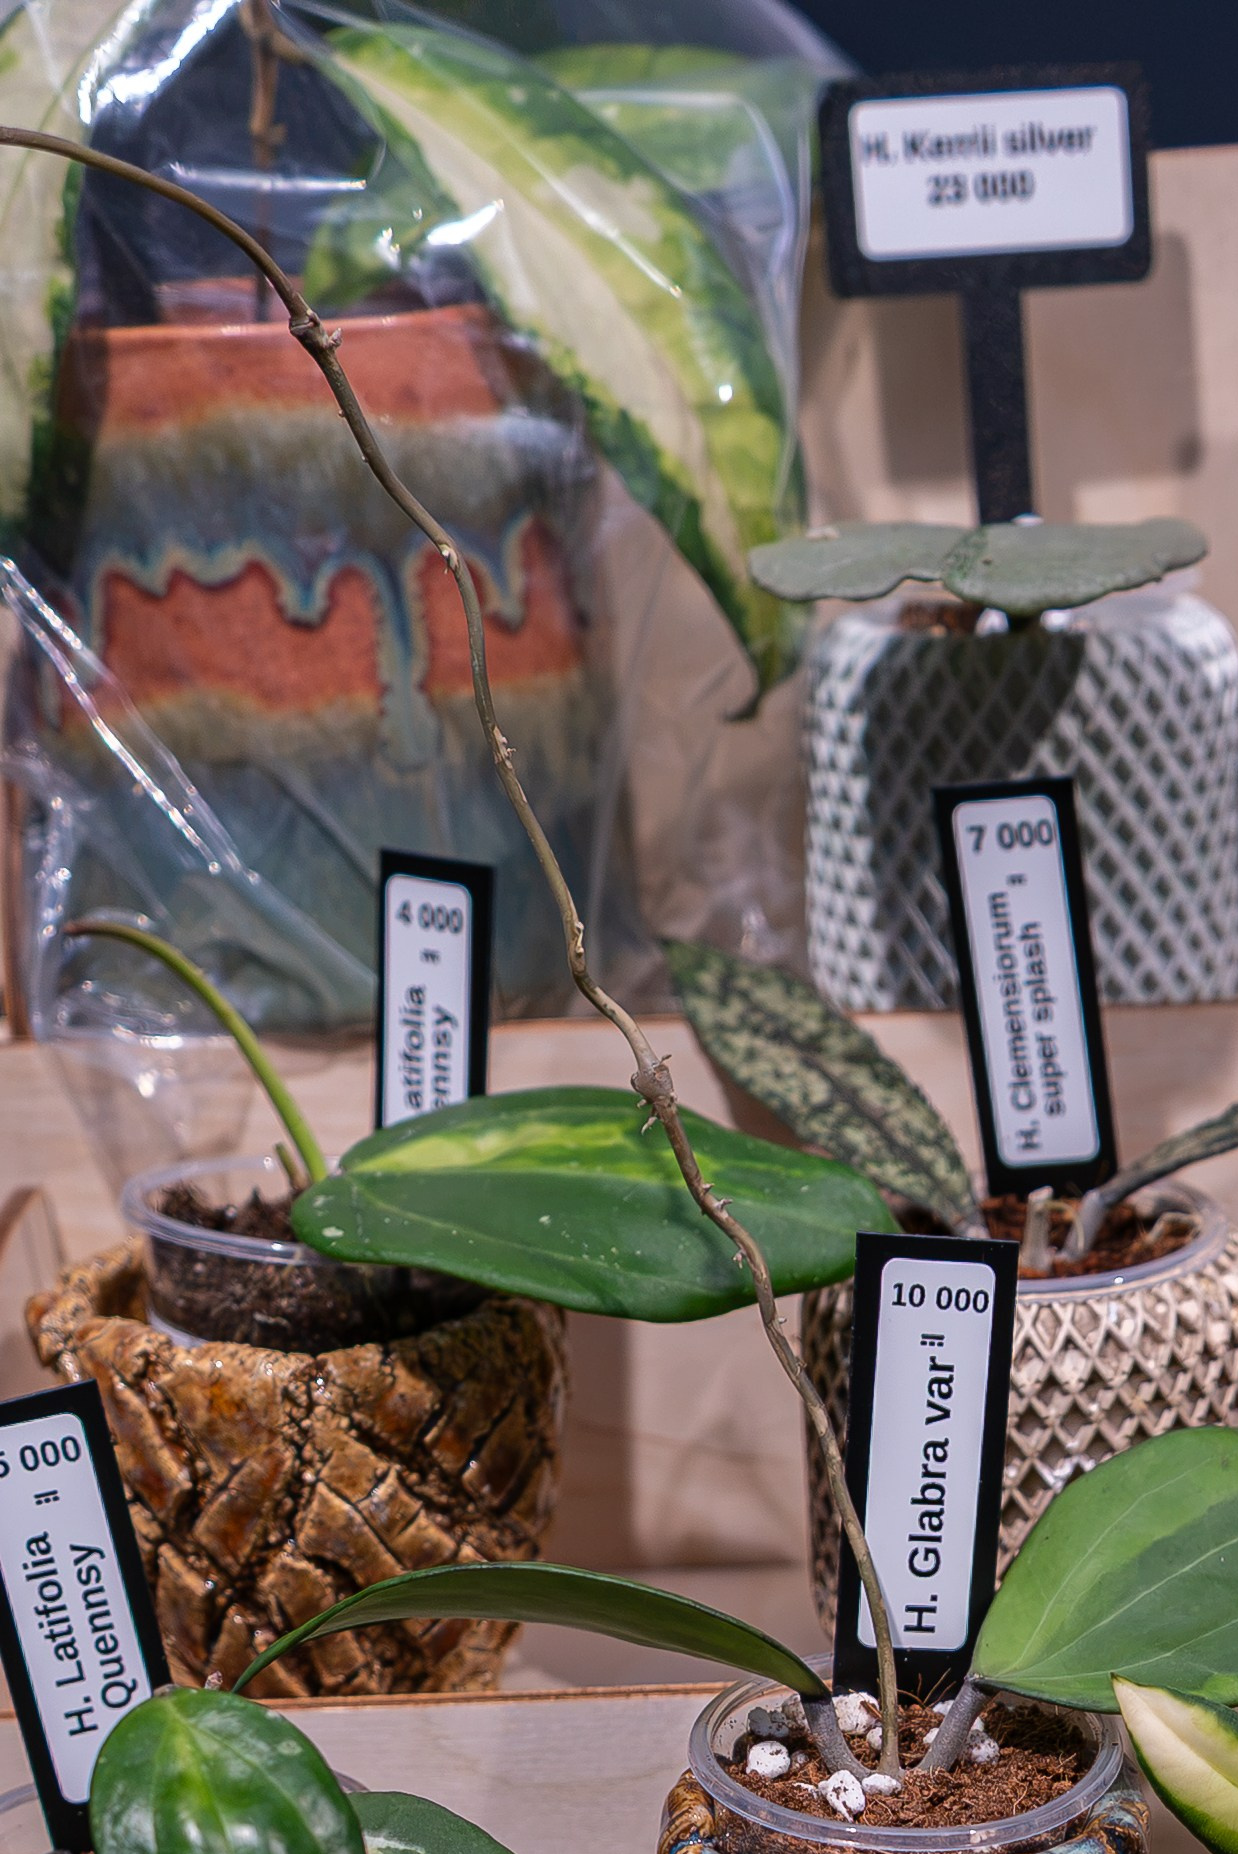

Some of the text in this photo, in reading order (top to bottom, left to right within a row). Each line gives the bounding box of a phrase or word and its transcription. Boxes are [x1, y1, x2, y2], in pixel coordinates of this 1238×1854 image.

[974, 170, 1034, 203] 000
[1002, 122, 1096, 156] silver
[966, 818, 1053, 853] 7 000
[397, 901, 464, 933] 4 000
[400, 986, 425, 1110] atifolia
[432, 1005, 458, 1106] ennsy
[988, 892, 1042, 1152] H. Clemensiorum
[1018, 922, 1065, 1117] super splash
[892, 1283, 990, 1313] 10 000
[20, 1436, 81, 1471] 000
[904, 1356, 954, 1633] H. Glabra var
[26, 1531, 98, 1736] H. Latifolia
[69, 1544, 138, 1711] Quennsy
